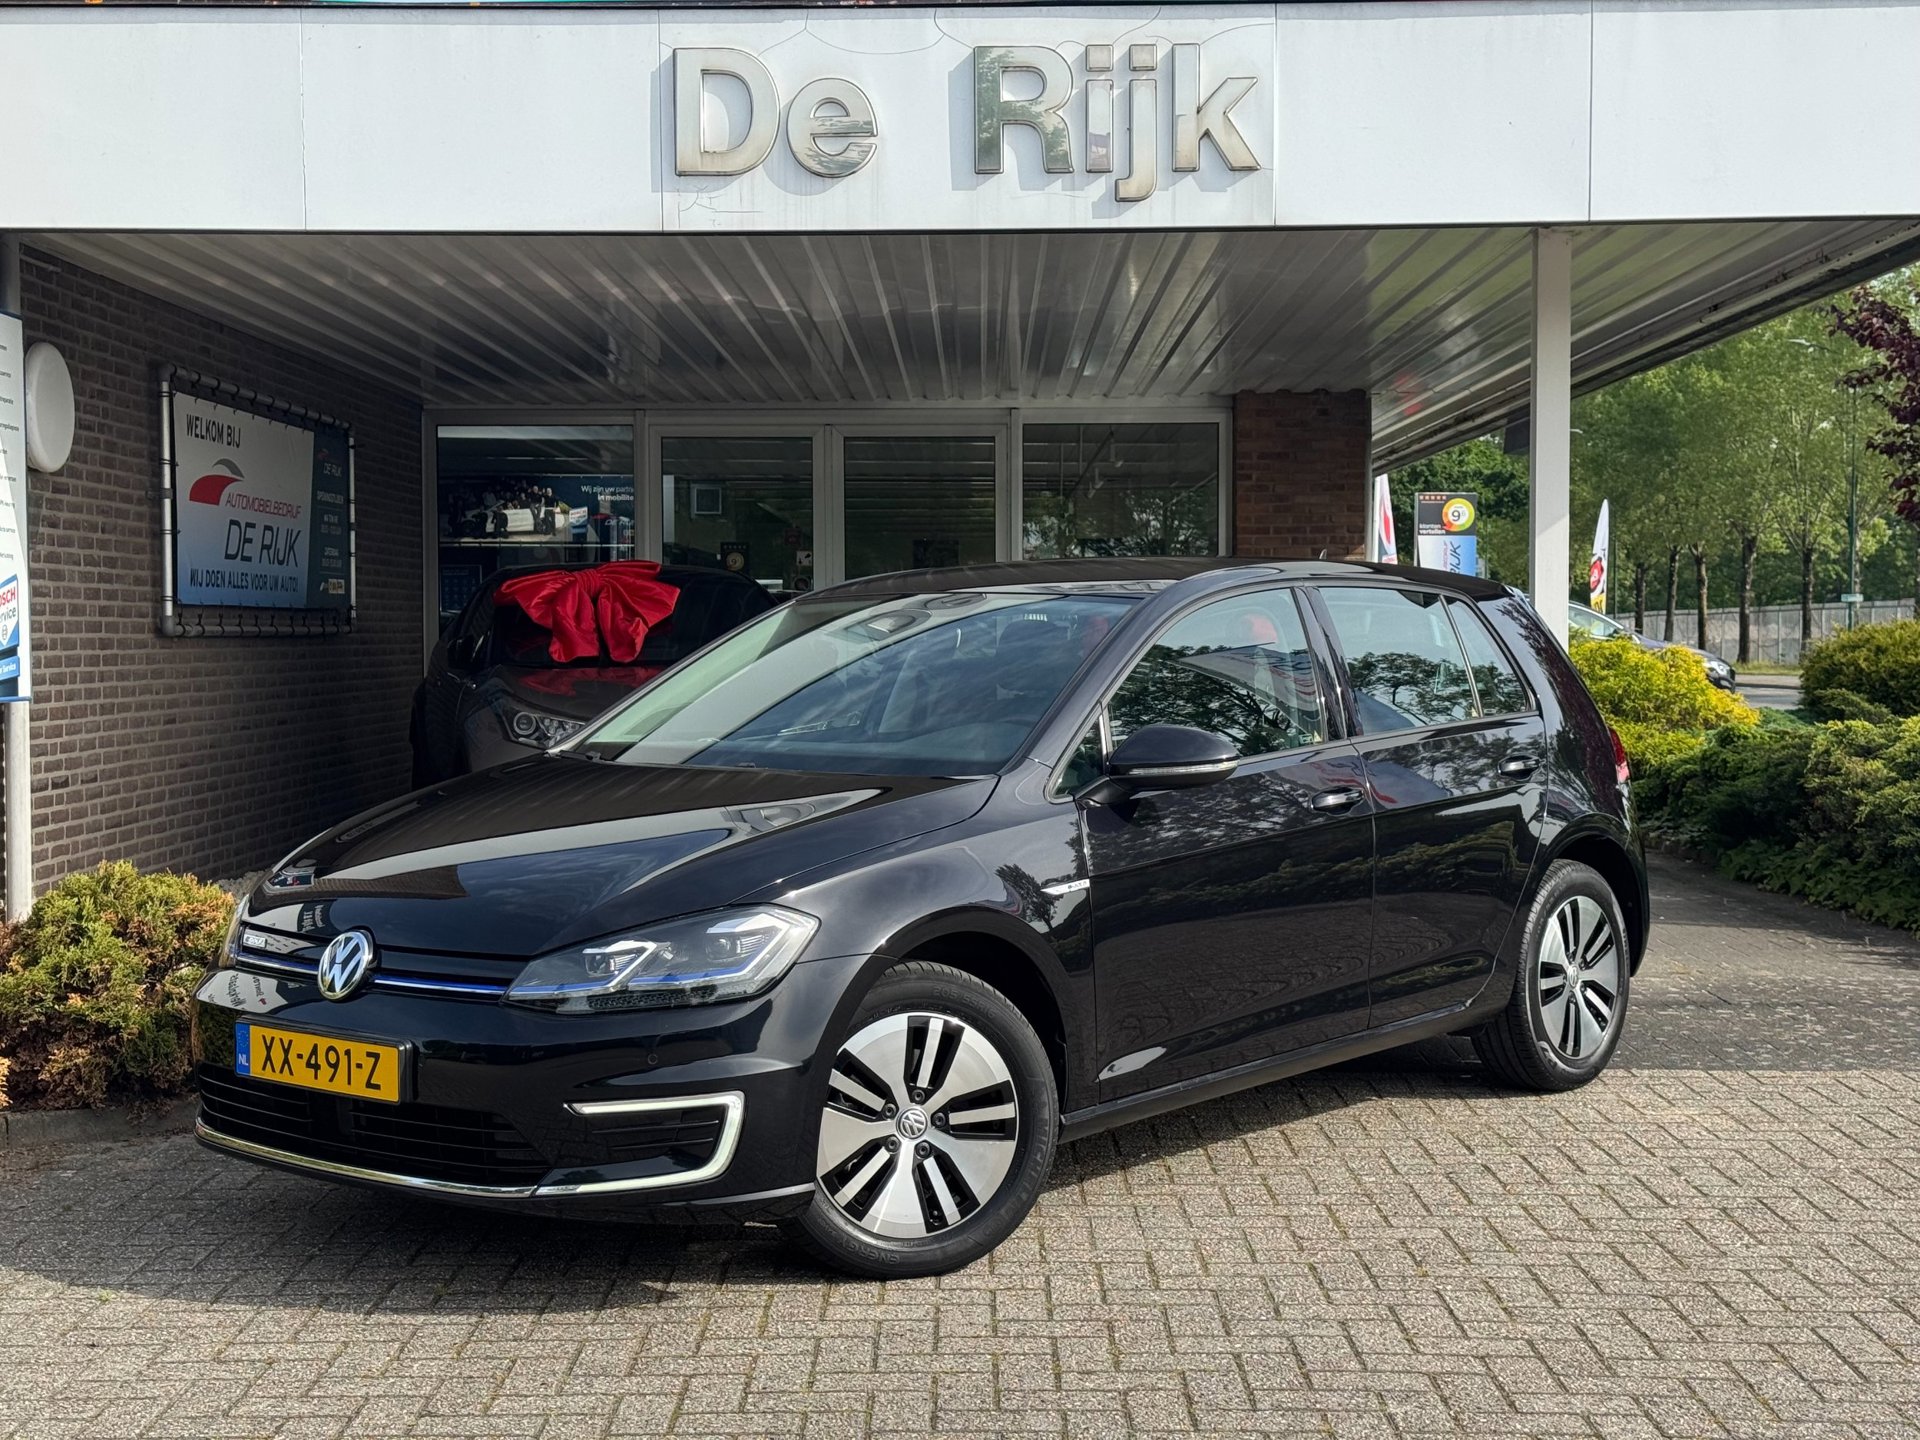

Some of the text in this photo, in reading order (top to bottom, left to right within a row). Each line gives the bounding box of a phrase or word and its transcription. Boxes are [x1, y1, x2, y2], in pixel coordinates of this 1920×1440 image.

[673, 43, 1261, 201] De Rijk
[186, 413, 241, 449] WELKOM BIJ
[225, 491, 302, 519] AUTOMOBIELBEDRIJF
[581, 485, 592, 494] Wij
[224, 519, 302, 568] DE RIJK
[190, 568, 204, 587] WIJ
[205, 569, 226, 589] DOEN
[227, 570, 249, 589] ALLES
[250, 572, 268, 592] VOOR
[268, 574, 280, 592] UW
[238, 1034, 382, 1091] NL XX-491-Z
